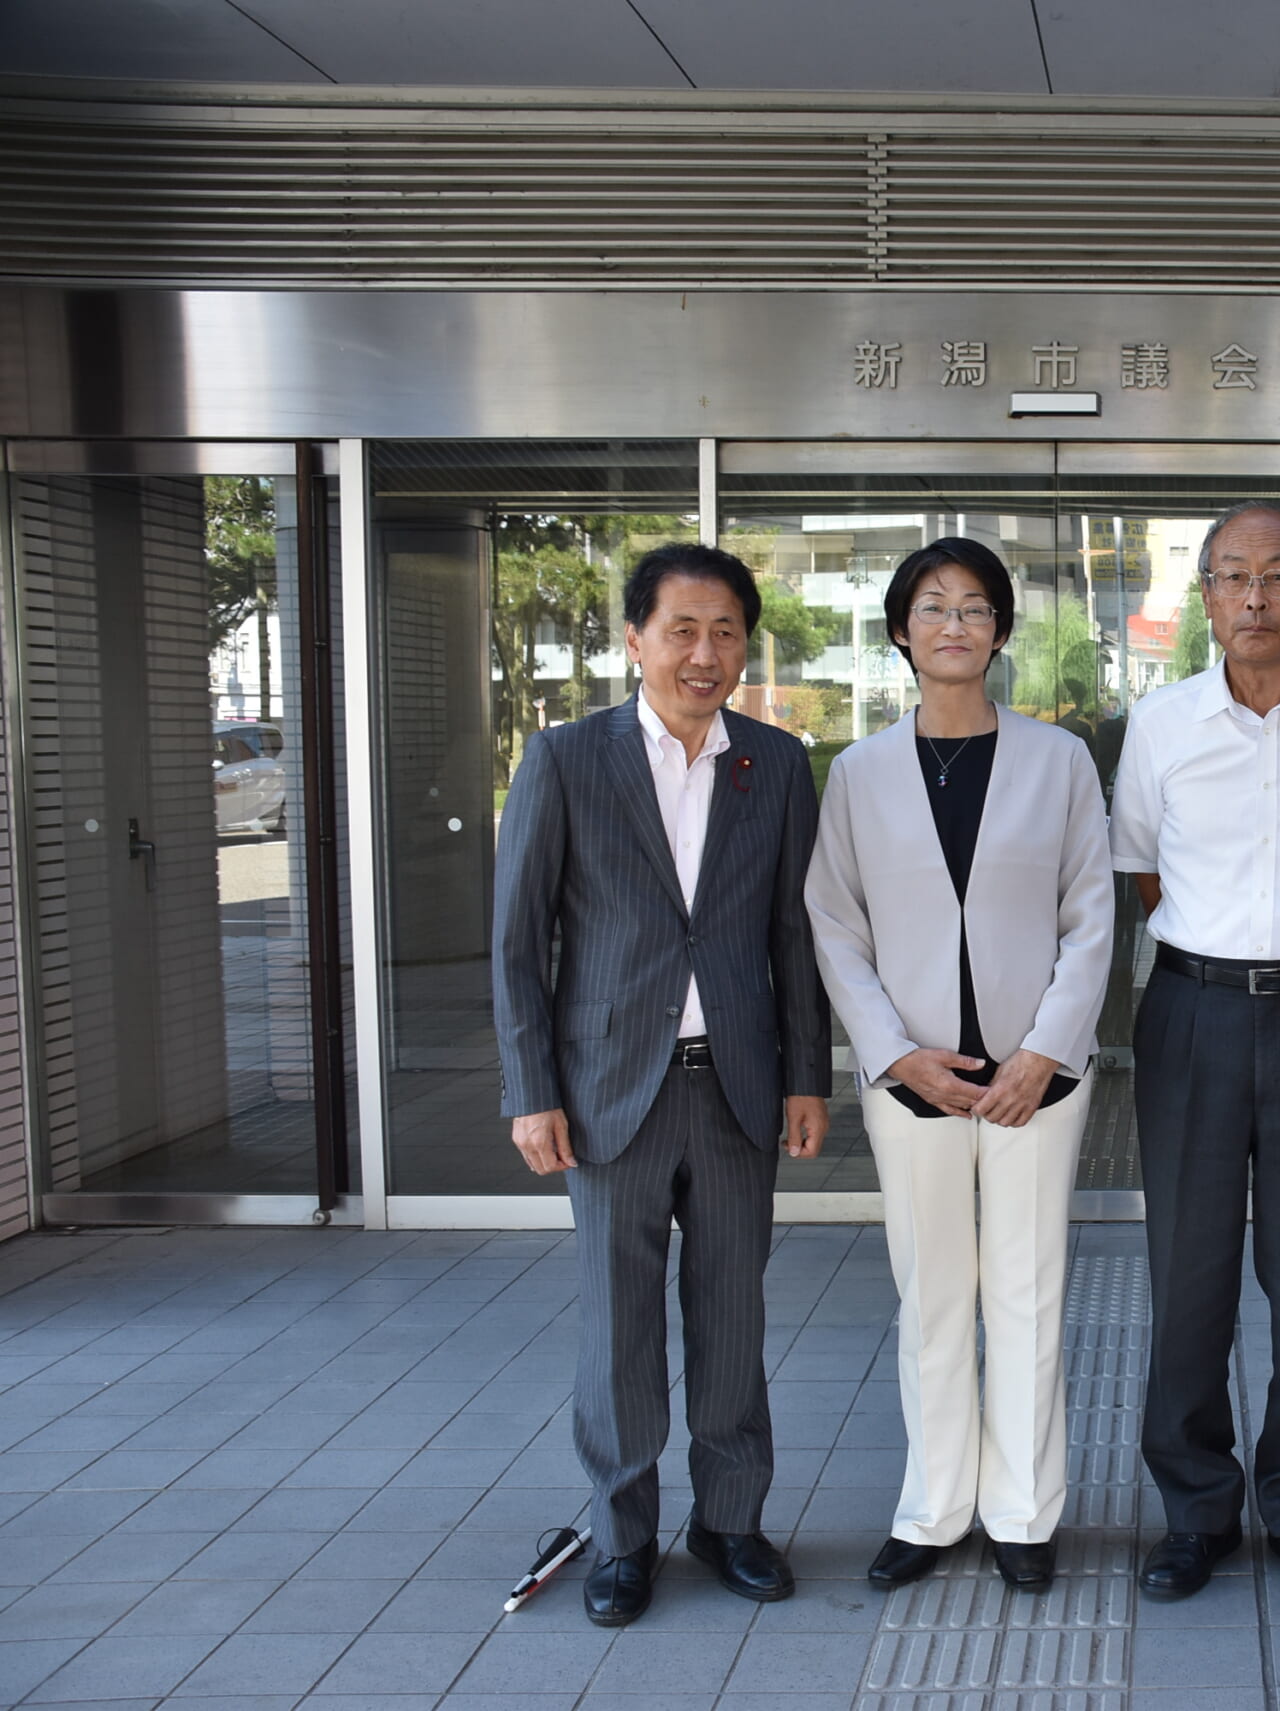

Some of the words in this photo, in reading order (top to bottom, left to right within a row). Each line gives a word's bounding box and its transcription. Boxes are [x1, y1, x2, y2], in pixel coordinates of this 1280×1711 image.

[853, 340, 1259, 390] 新潟市議会
